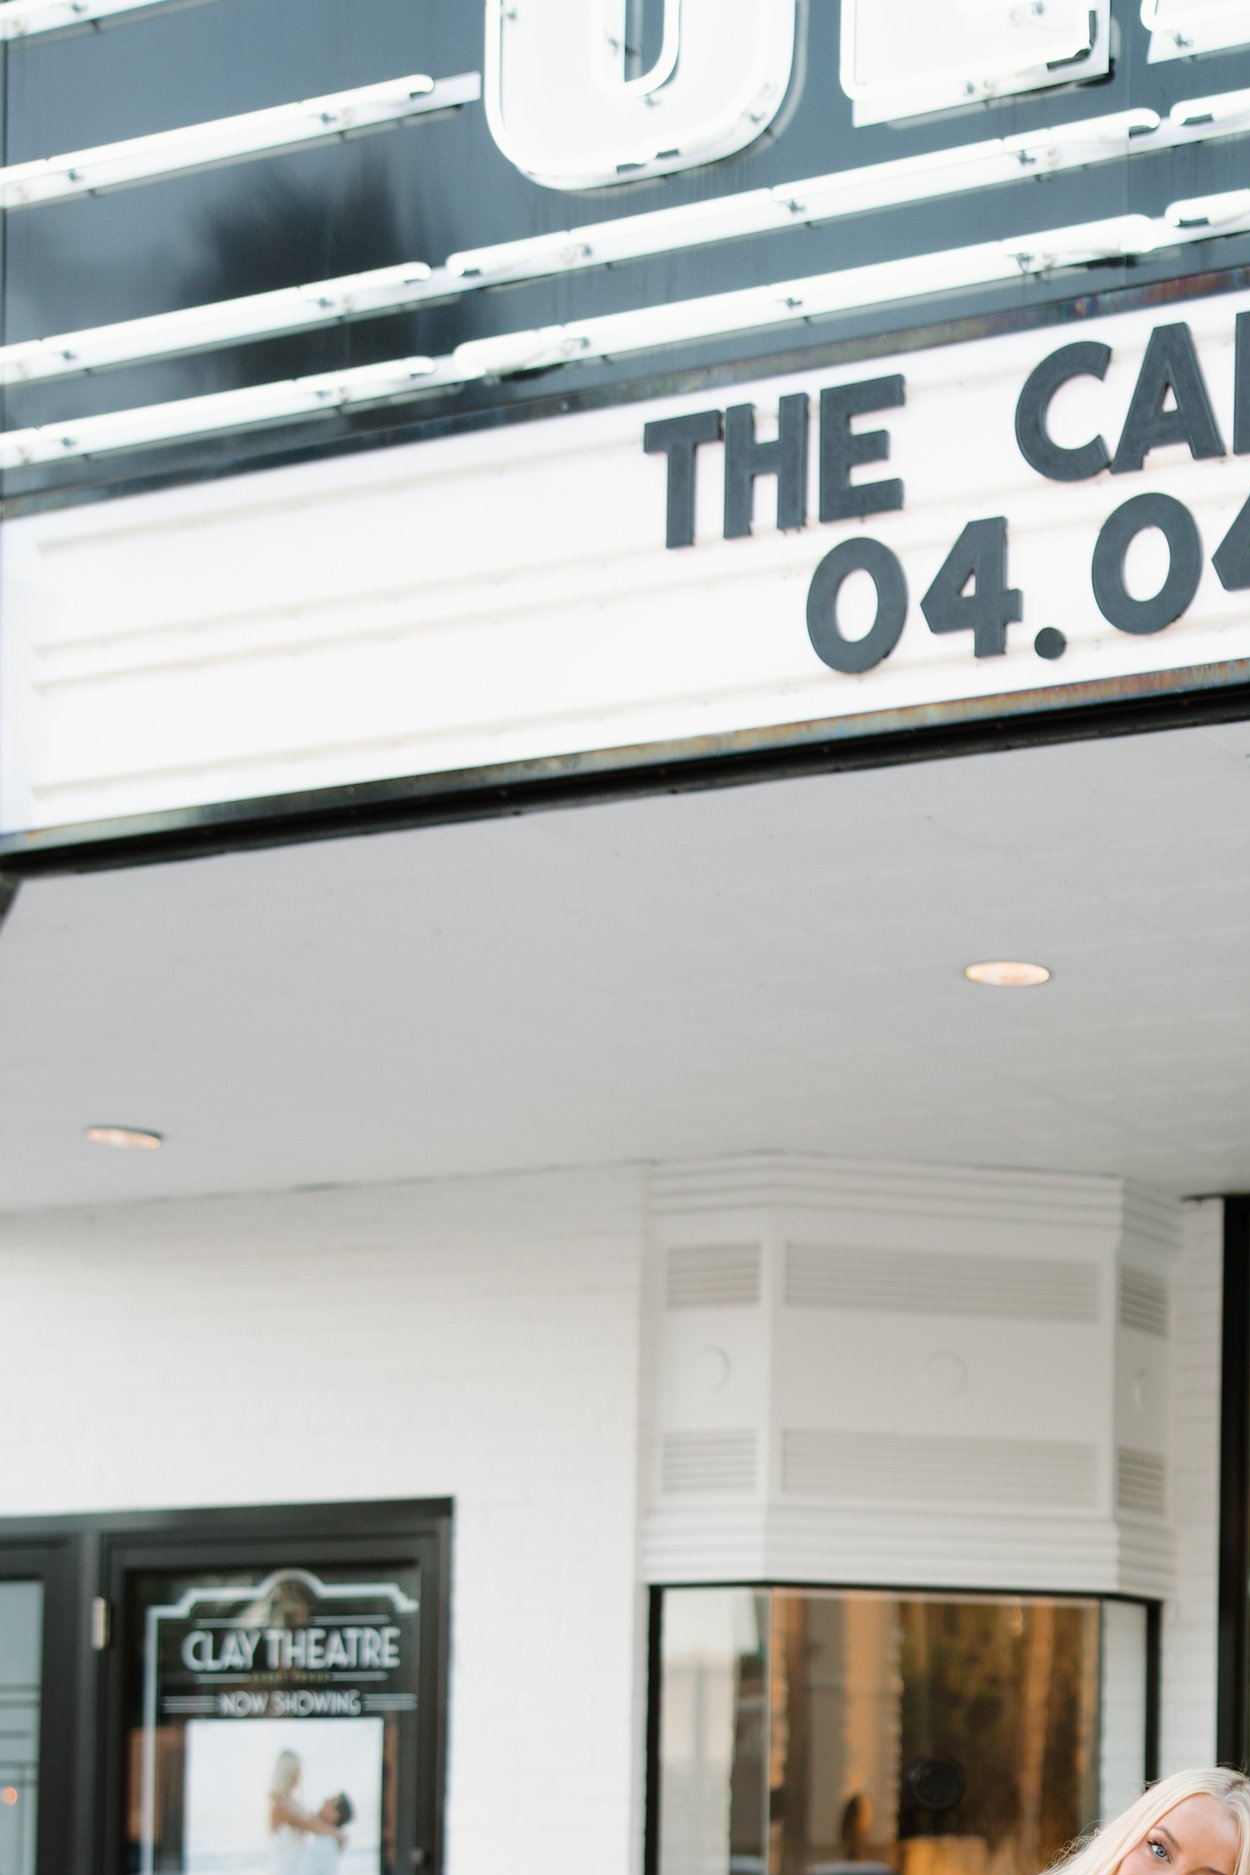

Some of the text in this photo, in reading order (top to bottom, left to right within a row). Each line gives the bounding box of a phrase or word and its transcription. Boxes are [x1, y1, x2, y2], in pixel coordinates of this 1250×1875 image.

[643, 373, 906, 549] THE
[182, 1626, 401, 1671] CLAY THEATRE
[217, 1689, 362, 1717] NOW SHOWING
